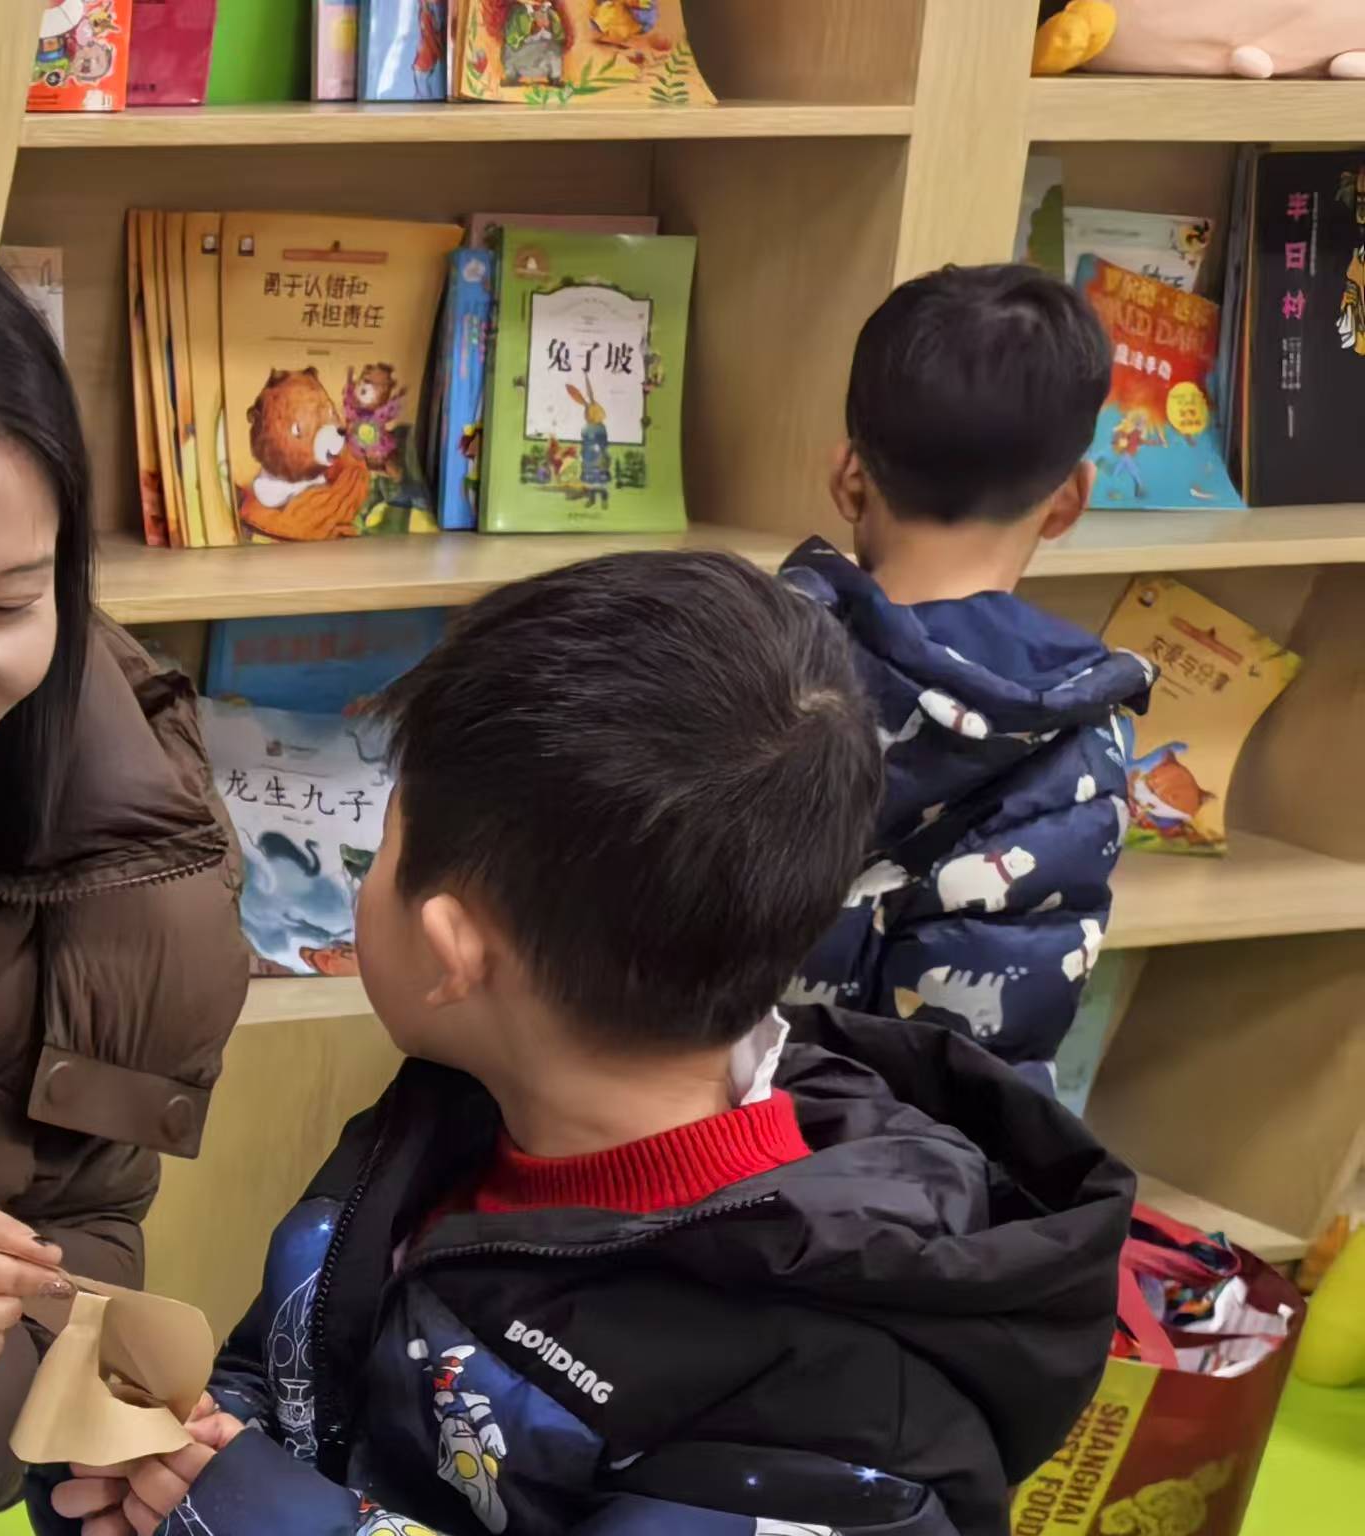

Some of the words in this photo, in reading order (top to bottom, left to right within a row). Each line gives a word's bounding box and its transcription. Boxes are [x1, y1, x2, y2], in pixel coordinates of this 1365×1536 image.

[263, 271, 372, 299] 勇于认错和
[301, 303, 385, 329] 承担责任
[225, 768, 374, 822] 龙生九子
[504, 1320, 614, 1404] BOSIDENG
[1052, 1402, 1129, 1526] SHANGHAI
